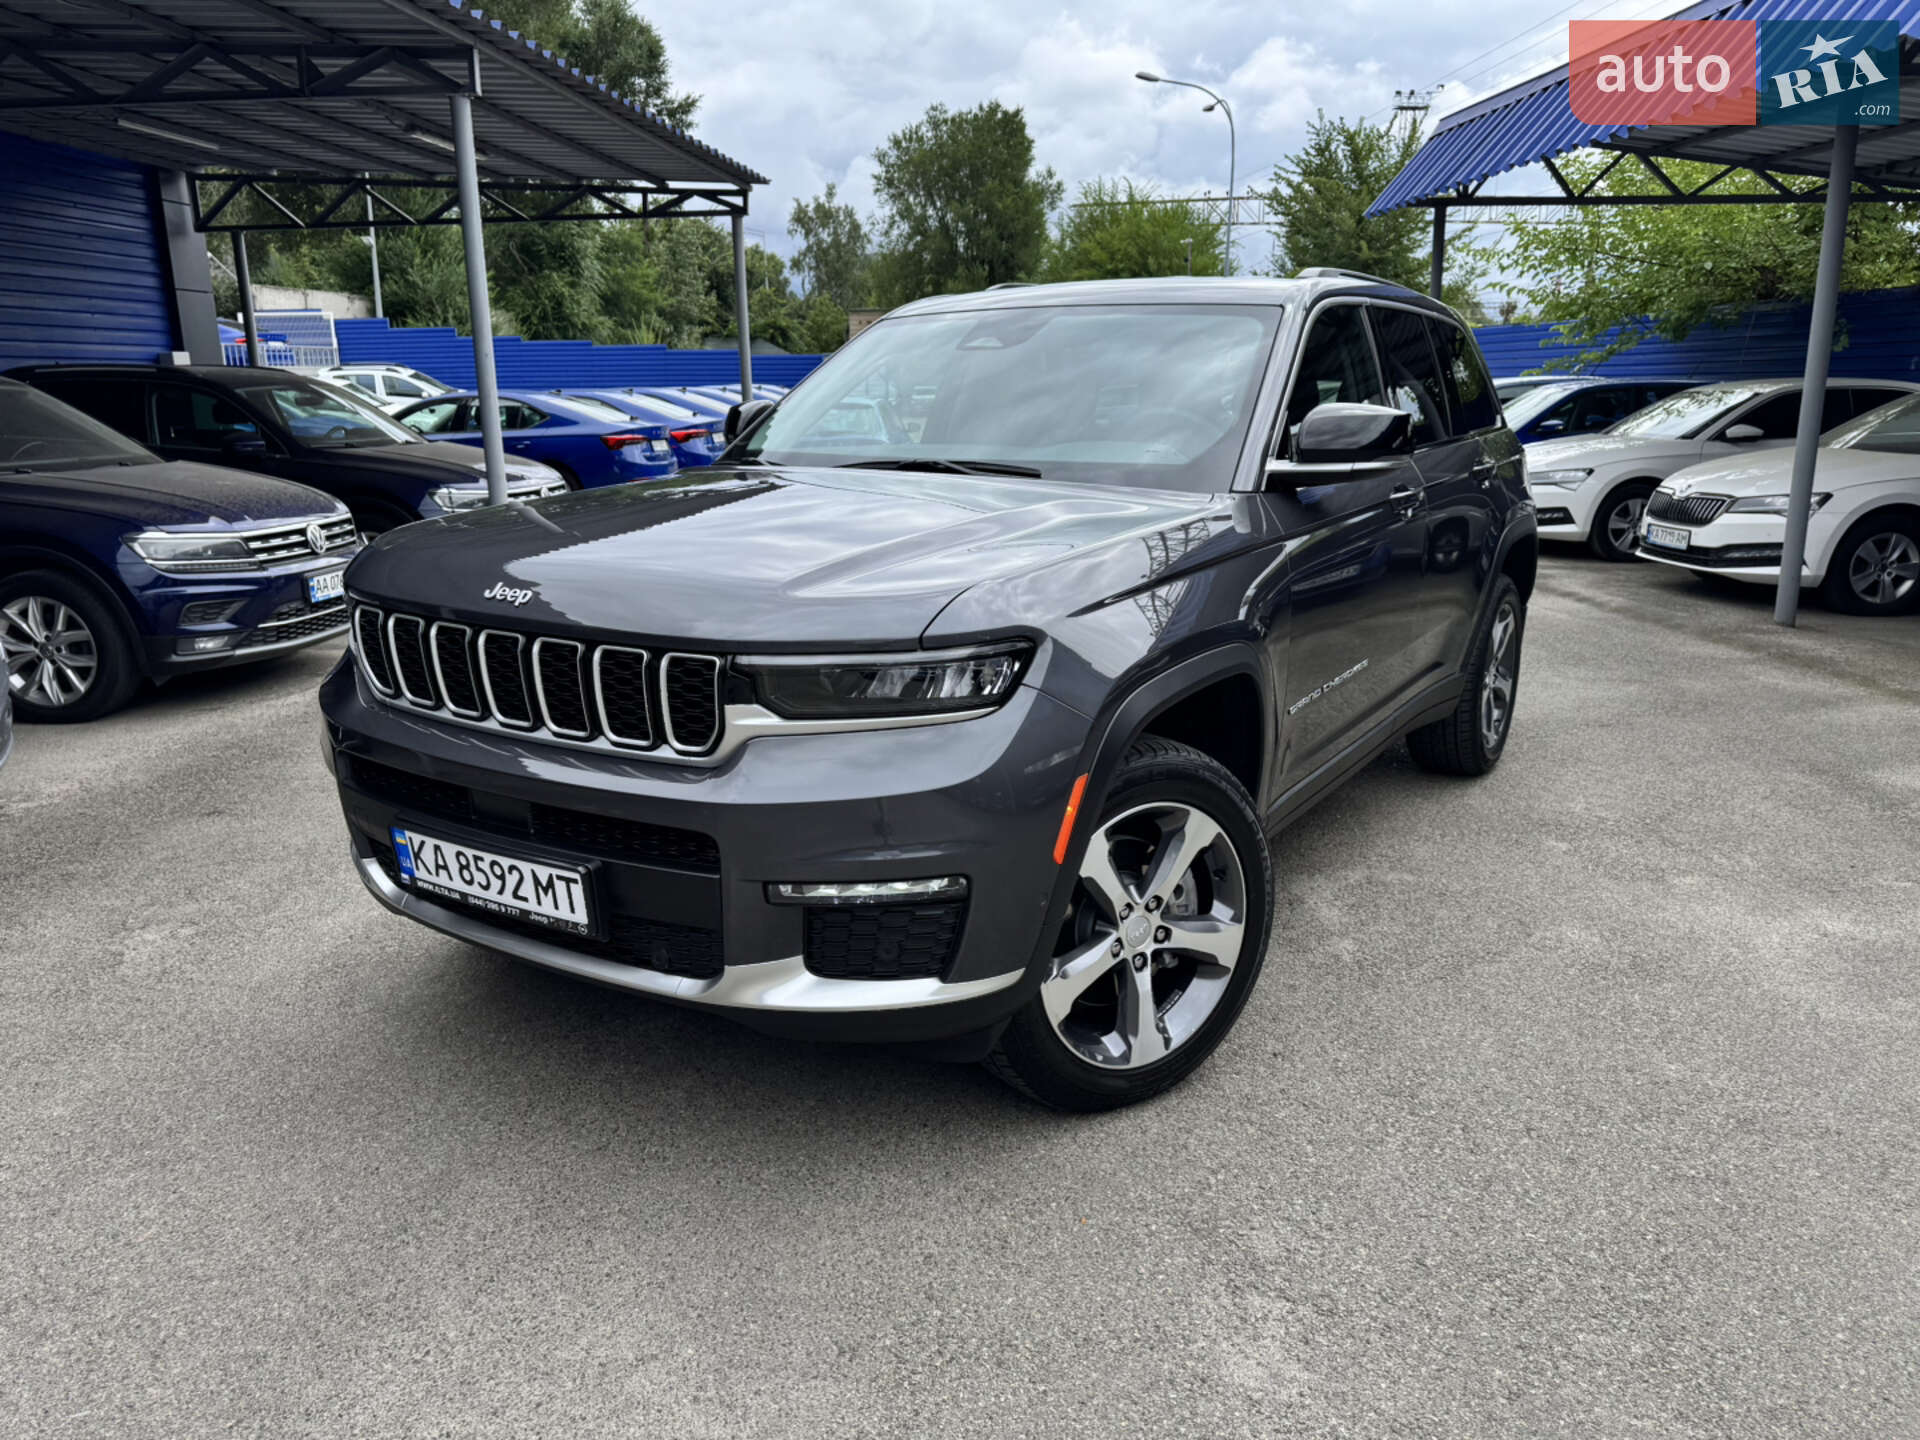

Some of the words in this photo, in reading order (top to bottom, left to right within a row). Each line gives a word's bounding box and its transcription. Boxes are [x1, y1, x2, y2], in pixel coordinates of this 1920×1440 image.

[483, 581, 533, 606] Jeep
[408, 835, 454, 882] KA
[455, 850, 530, 904] 8592
[530, 868, 579, 915] MT
